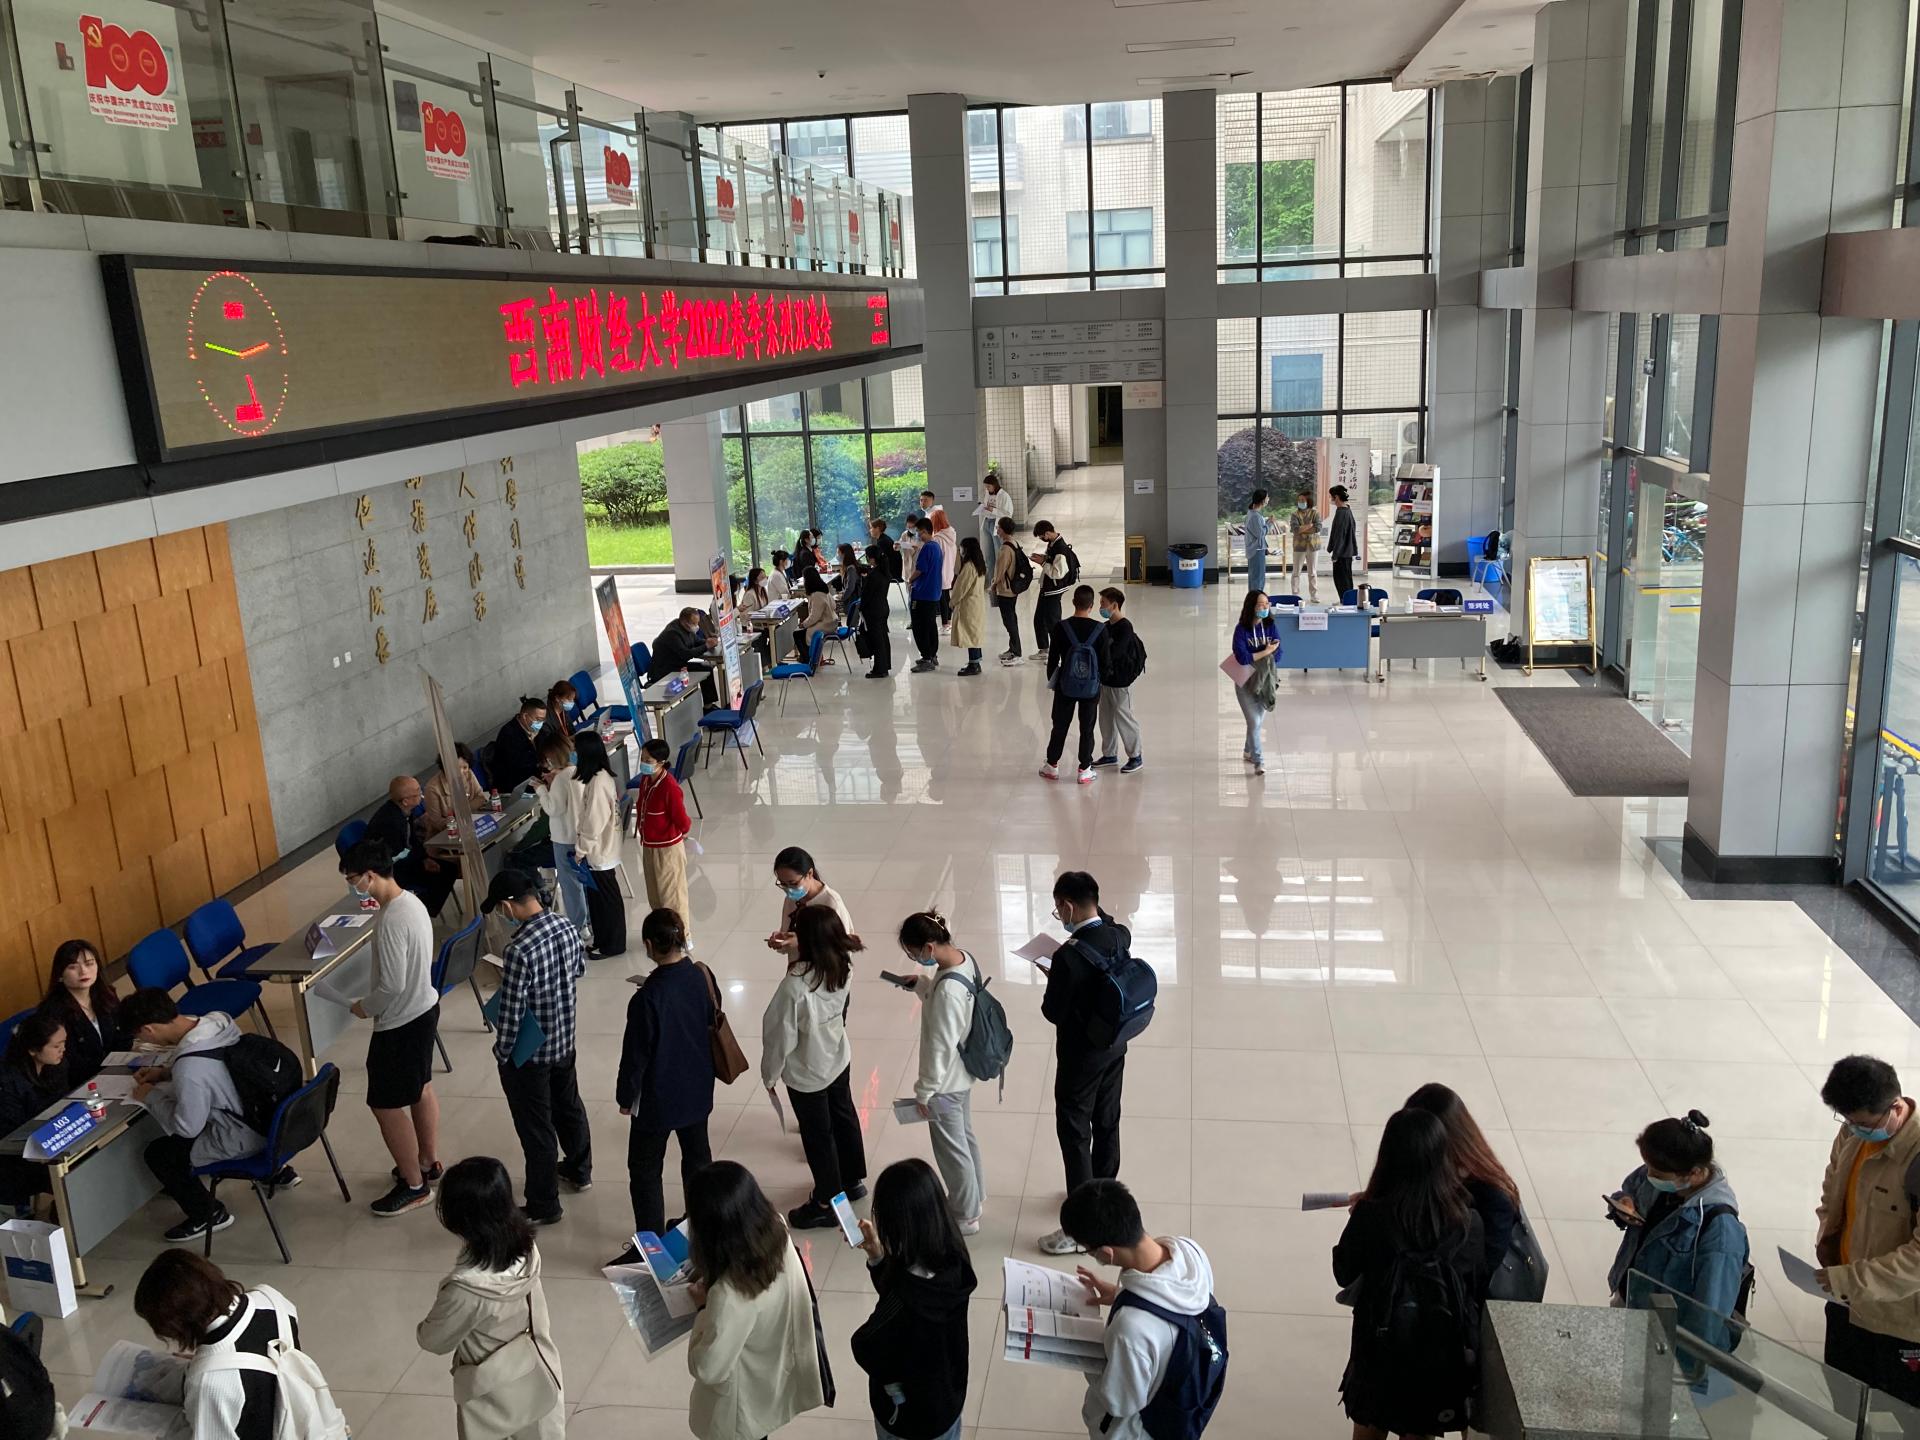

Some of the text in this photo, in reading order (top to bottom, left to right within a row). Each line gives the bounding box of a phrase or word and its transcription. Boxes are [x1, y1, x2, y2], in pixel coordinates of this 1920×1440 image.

[79, 15, 168, 96] 100
[88, 93, 175, 112] 庆祝中国共产党成立100周年
[501, 287, 832, 387] 西南财经大学2022春季系列双选会
[52, 1116, 71, 1131] A03
